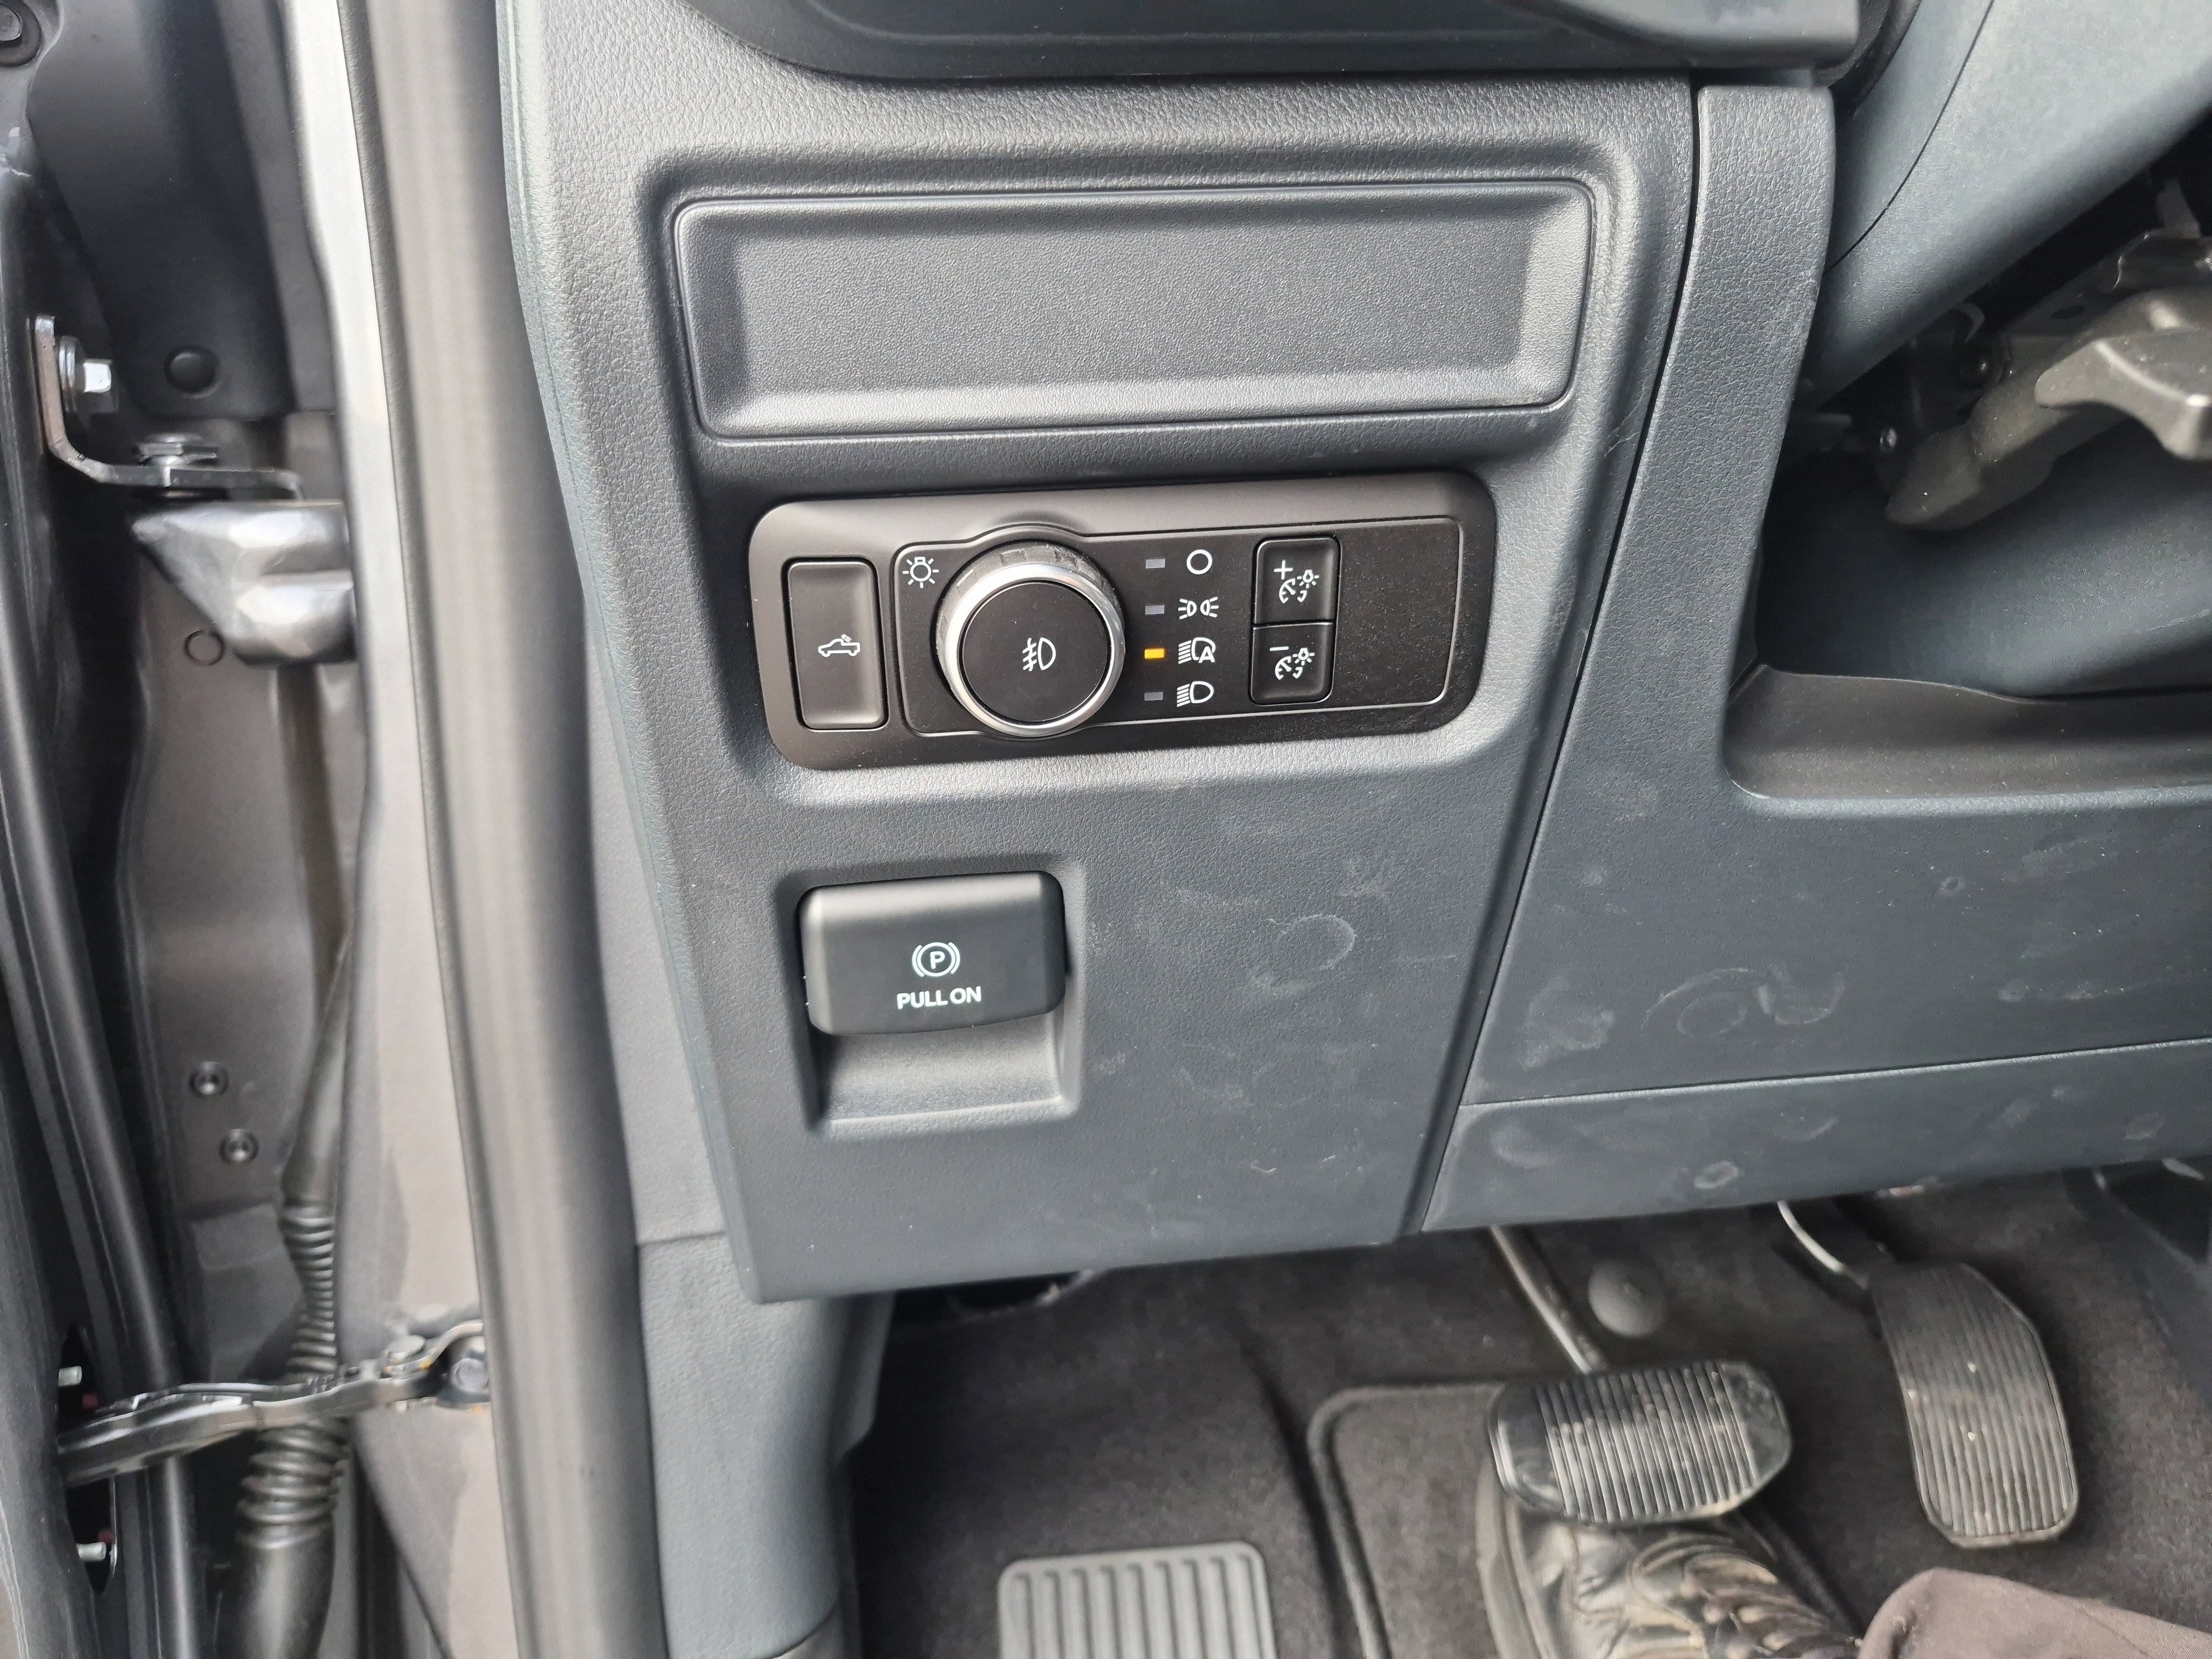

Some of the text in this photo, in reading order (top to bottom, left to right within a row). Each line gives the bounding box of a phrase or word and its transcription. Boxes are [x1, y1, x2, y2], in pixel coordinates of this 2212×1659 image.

[930, 950, 946, 969] P
[896, 986, 982, 1010] PULL ON
